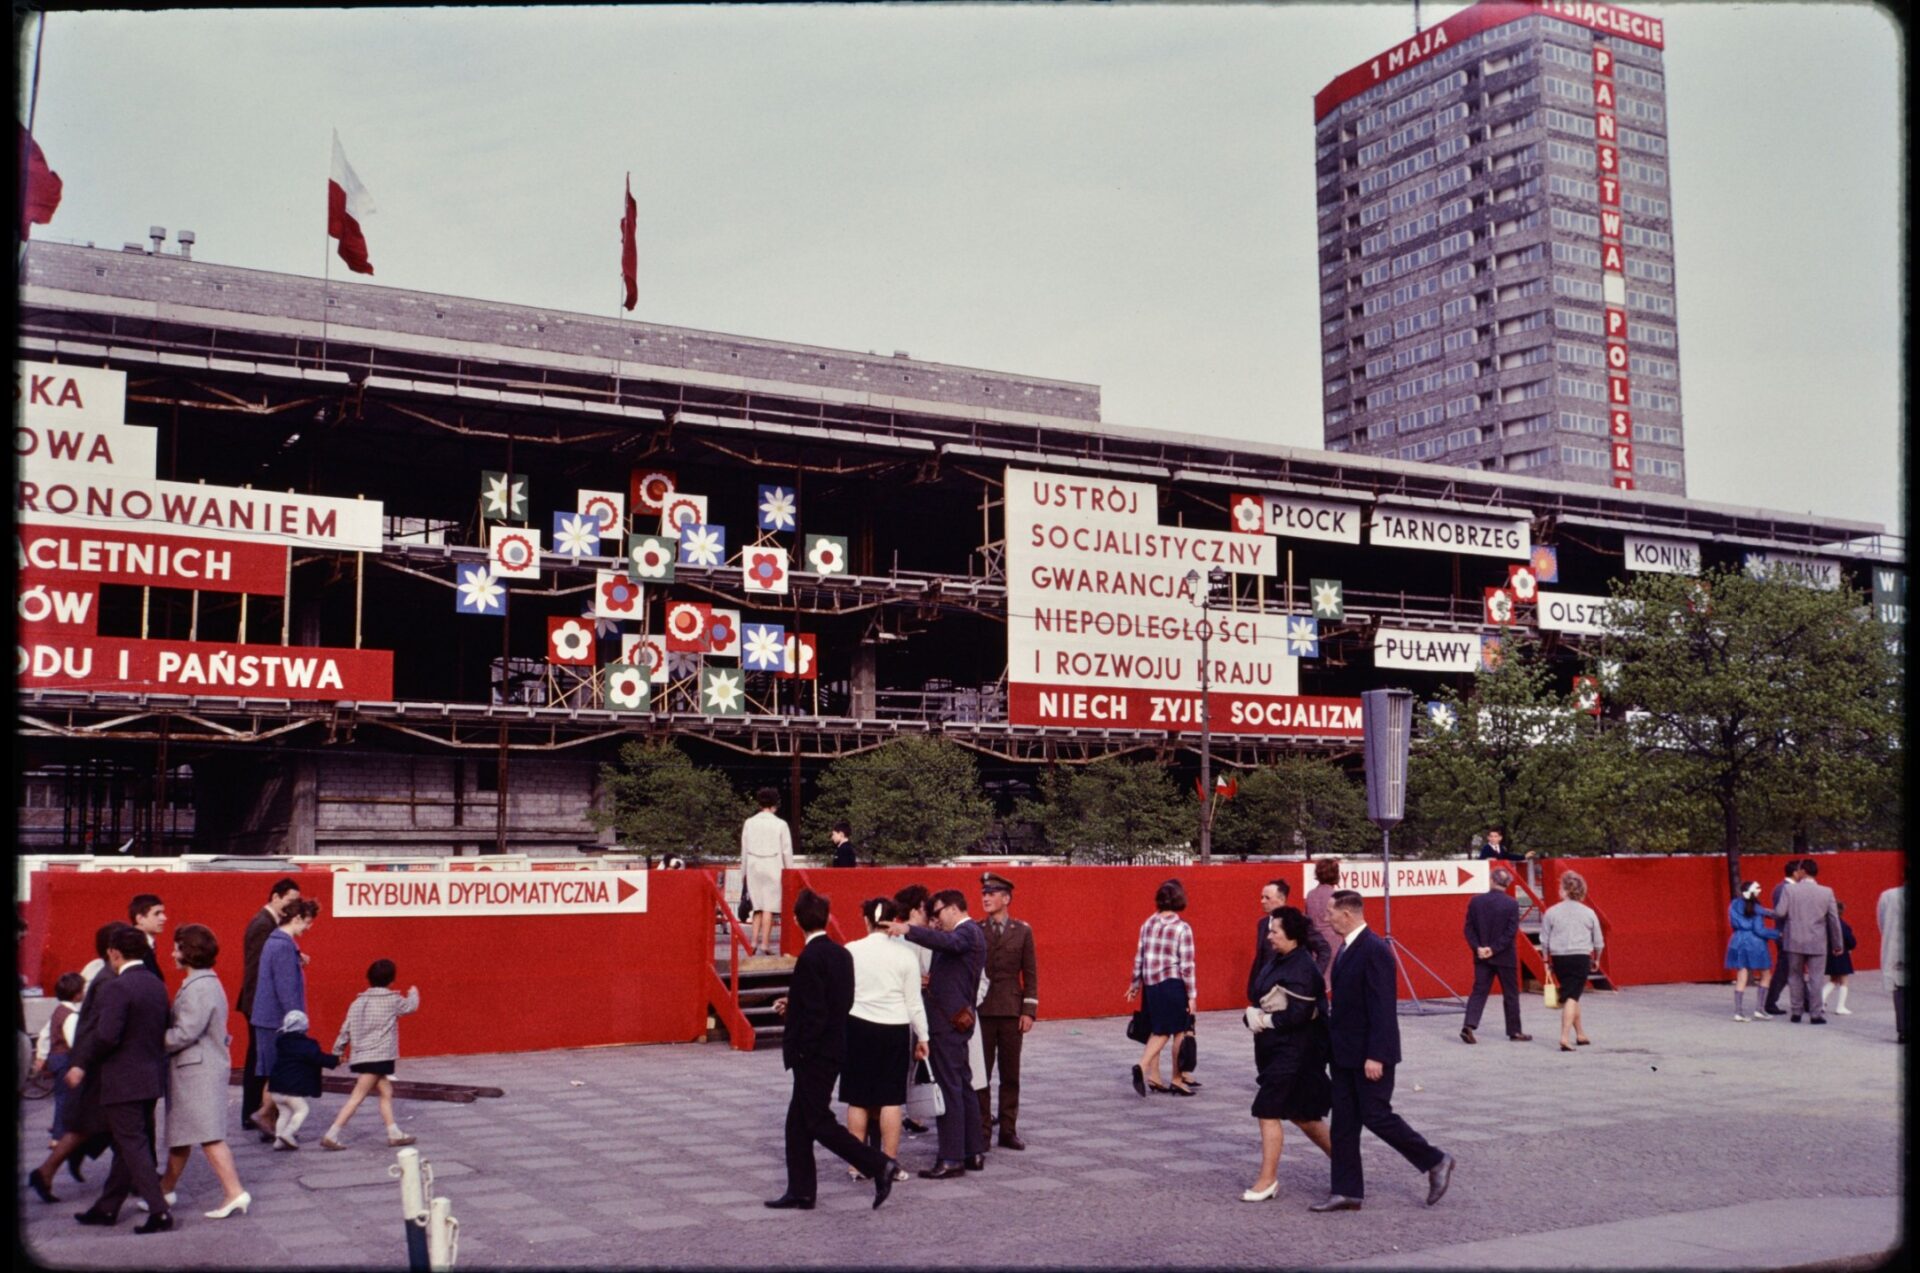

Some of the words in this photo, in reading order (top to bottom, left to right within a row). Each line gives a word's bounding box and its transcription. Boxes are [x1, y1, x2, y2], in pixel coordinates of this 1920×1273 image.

[1371, 62, 1379, 80] 1
[1388, 27, 1448, 72] MAJA
[18, 481, 338, 538] RONOWANIEM
[1033, 481, 1138, 515] USTRÓJ
[1272, 503, 1346, 534] PŁOCK
[1383, 516, 1520, 550] TARNOBRZEG
[1032, 524, 1263, 567] SOCJALISTYCZNY
[1634, 542, 1690, 568] KONIN
[1032, 565, 1192, 601] GWARANCJA
[1034, 607, 1257, 645] NIEPODLEGŁOŚCI
[1035, 649, 1040, 674] I
[1056, 651, 1182, 681] ROZWOJU
[1386, 638, 1471, 664] PUŁAWY
[119, 649, 129, 681] I
[158, 650, 345, 690] PAŃSTWA
[1039, 692, 1127, 721] NIECH
[1230, 701, 1363, 729] SOCJALIZM
[346, 882, 441, 907] TRYBUNA
[448, 881, 610, 905] DYPLOMATYCZNA
[1335, 870, 1391, 890] YBUN
[1397, 869, 1448, 887] PRAWA
